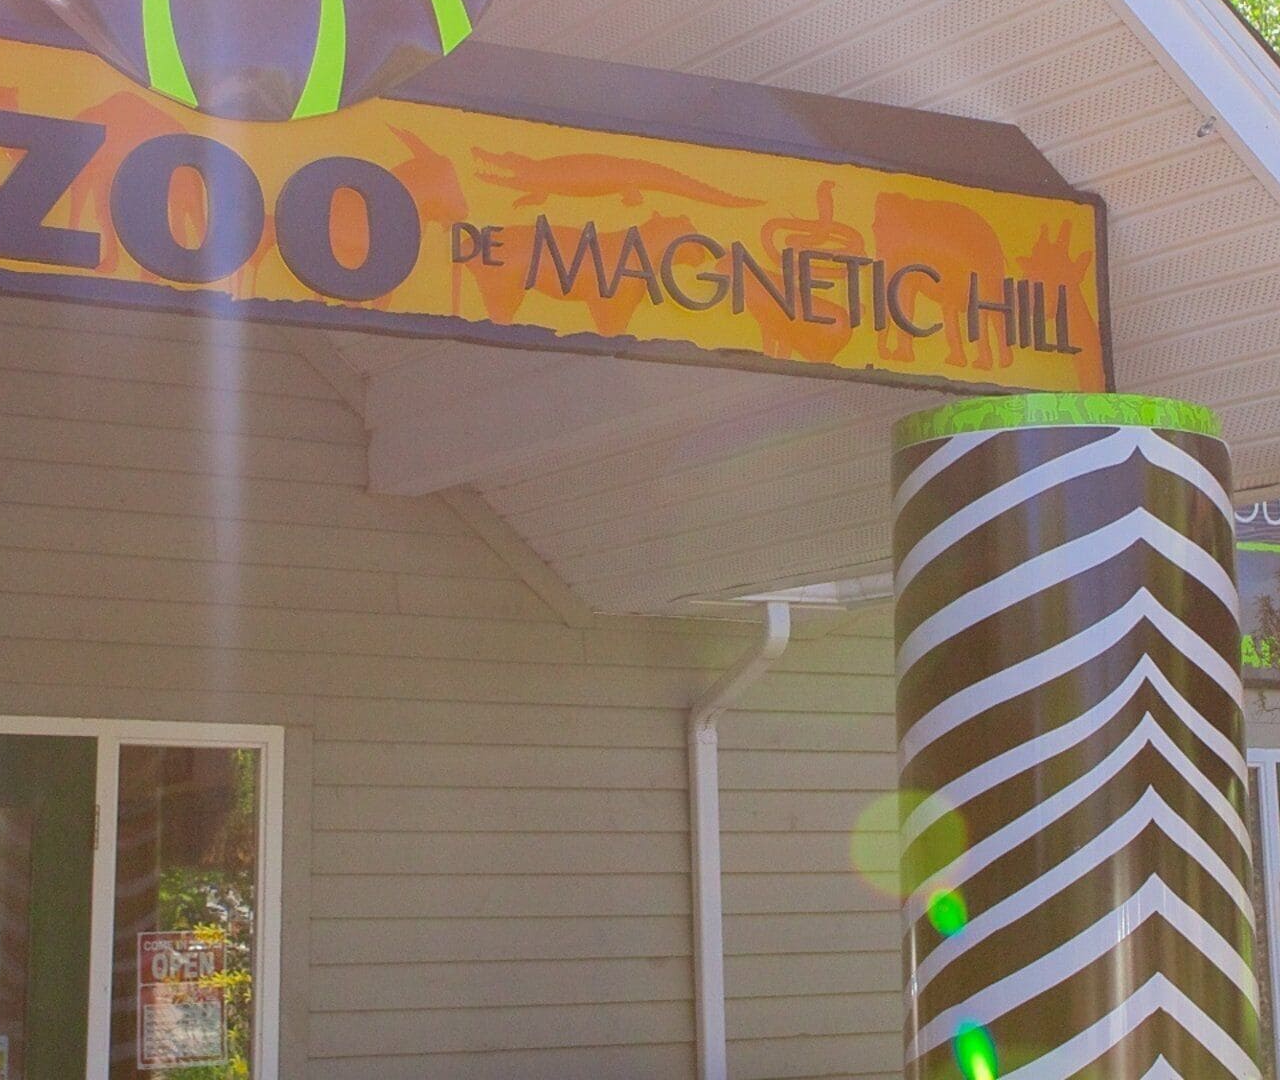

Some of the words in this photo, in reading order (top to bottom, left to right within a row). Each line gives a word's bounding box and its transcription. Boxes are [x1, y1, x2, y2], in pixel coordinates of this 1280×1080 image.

[451, 219, 505, 266] DE
[525, 213, 944, 338] MAGNETIC
[967, 271, 1083, 356] HILL
[152, 951, 215, 980] OPEN
